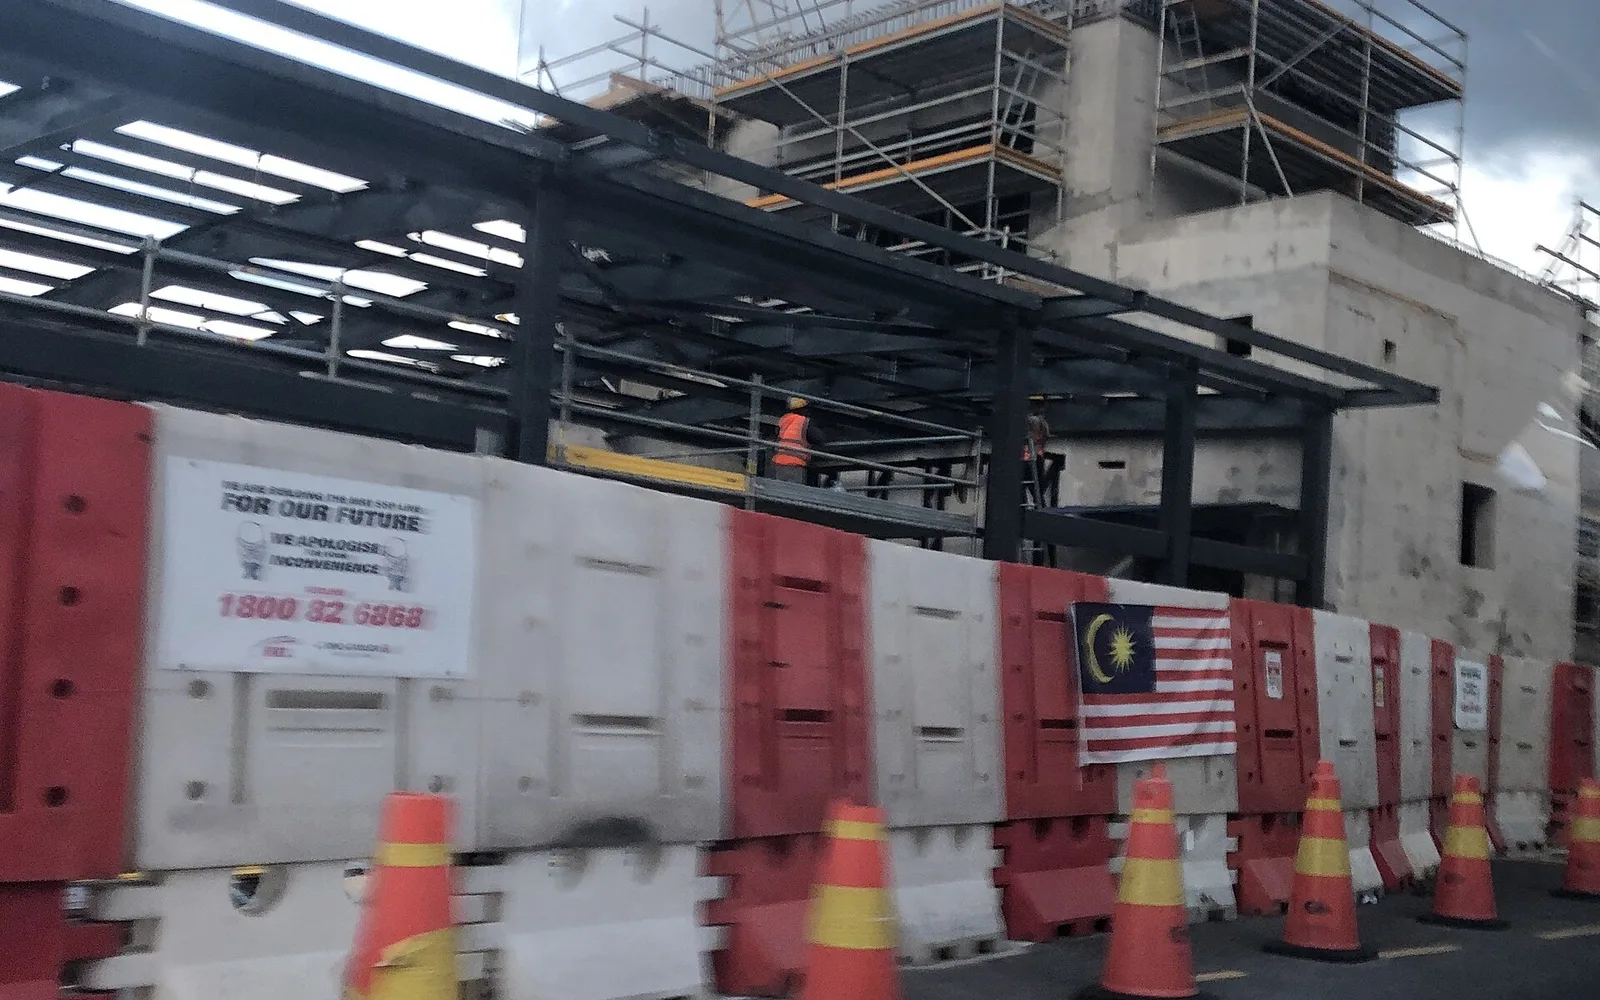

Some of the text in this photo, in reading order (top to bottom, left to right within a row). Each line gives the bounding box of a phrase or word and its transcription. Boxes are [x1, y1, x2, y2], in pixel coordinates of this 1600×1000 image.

[221, 492, 420, 533] FOR OUR FUTURE
[270, 532, 383, 556] WE APOLOGISE
[269, 555, 381, 575] INCONVENIENCE
[219, 594, 425, 629] 1800 82 6868
